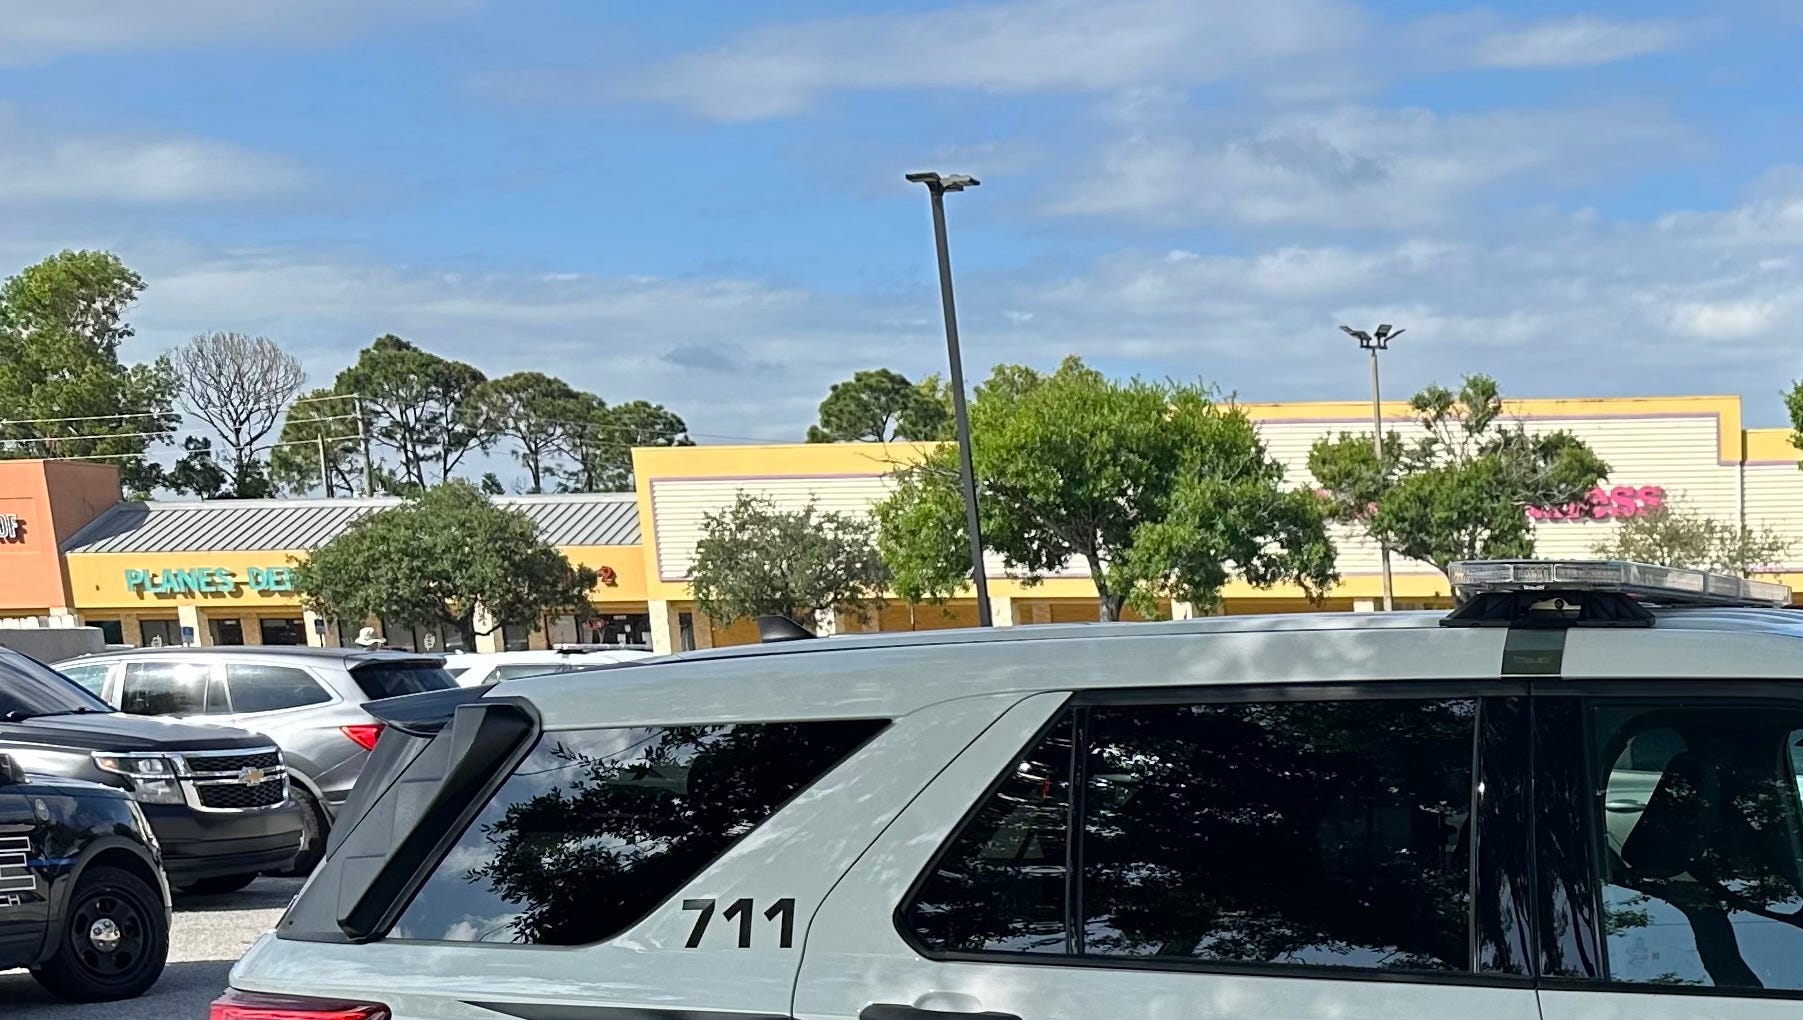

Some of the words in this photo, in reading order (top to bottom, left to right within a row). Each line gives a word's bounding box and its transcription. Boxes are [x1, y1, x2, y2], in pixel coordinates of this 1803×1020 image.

[125, 567, 235, 594] PLANES
[247, 566, 294, 592] DE
[682, 898, 796, 948] 711
